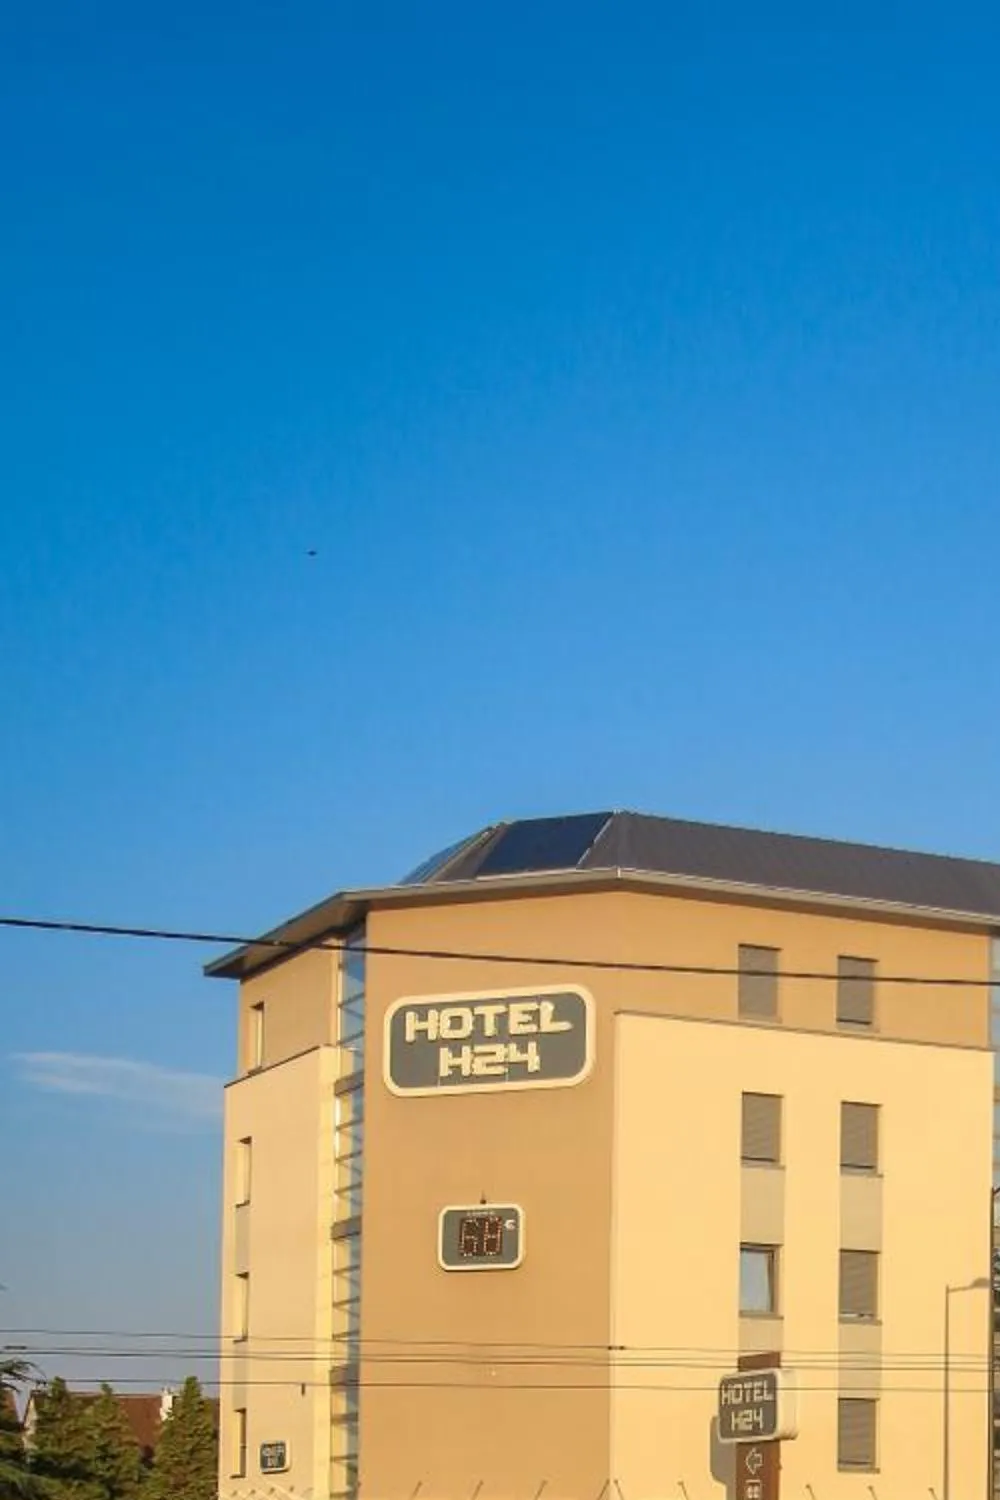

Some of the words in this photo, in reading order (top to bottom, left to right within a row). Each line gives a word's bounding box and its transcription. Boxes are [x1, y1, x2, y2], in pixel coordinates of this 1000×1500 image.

[405, 1001, 572, 1042] HOTEL
[439, 1042, 540, 1077] H24
[721, 1380, 773, 1405] HOTEL
[731, 1407, 763, 1431] H24
